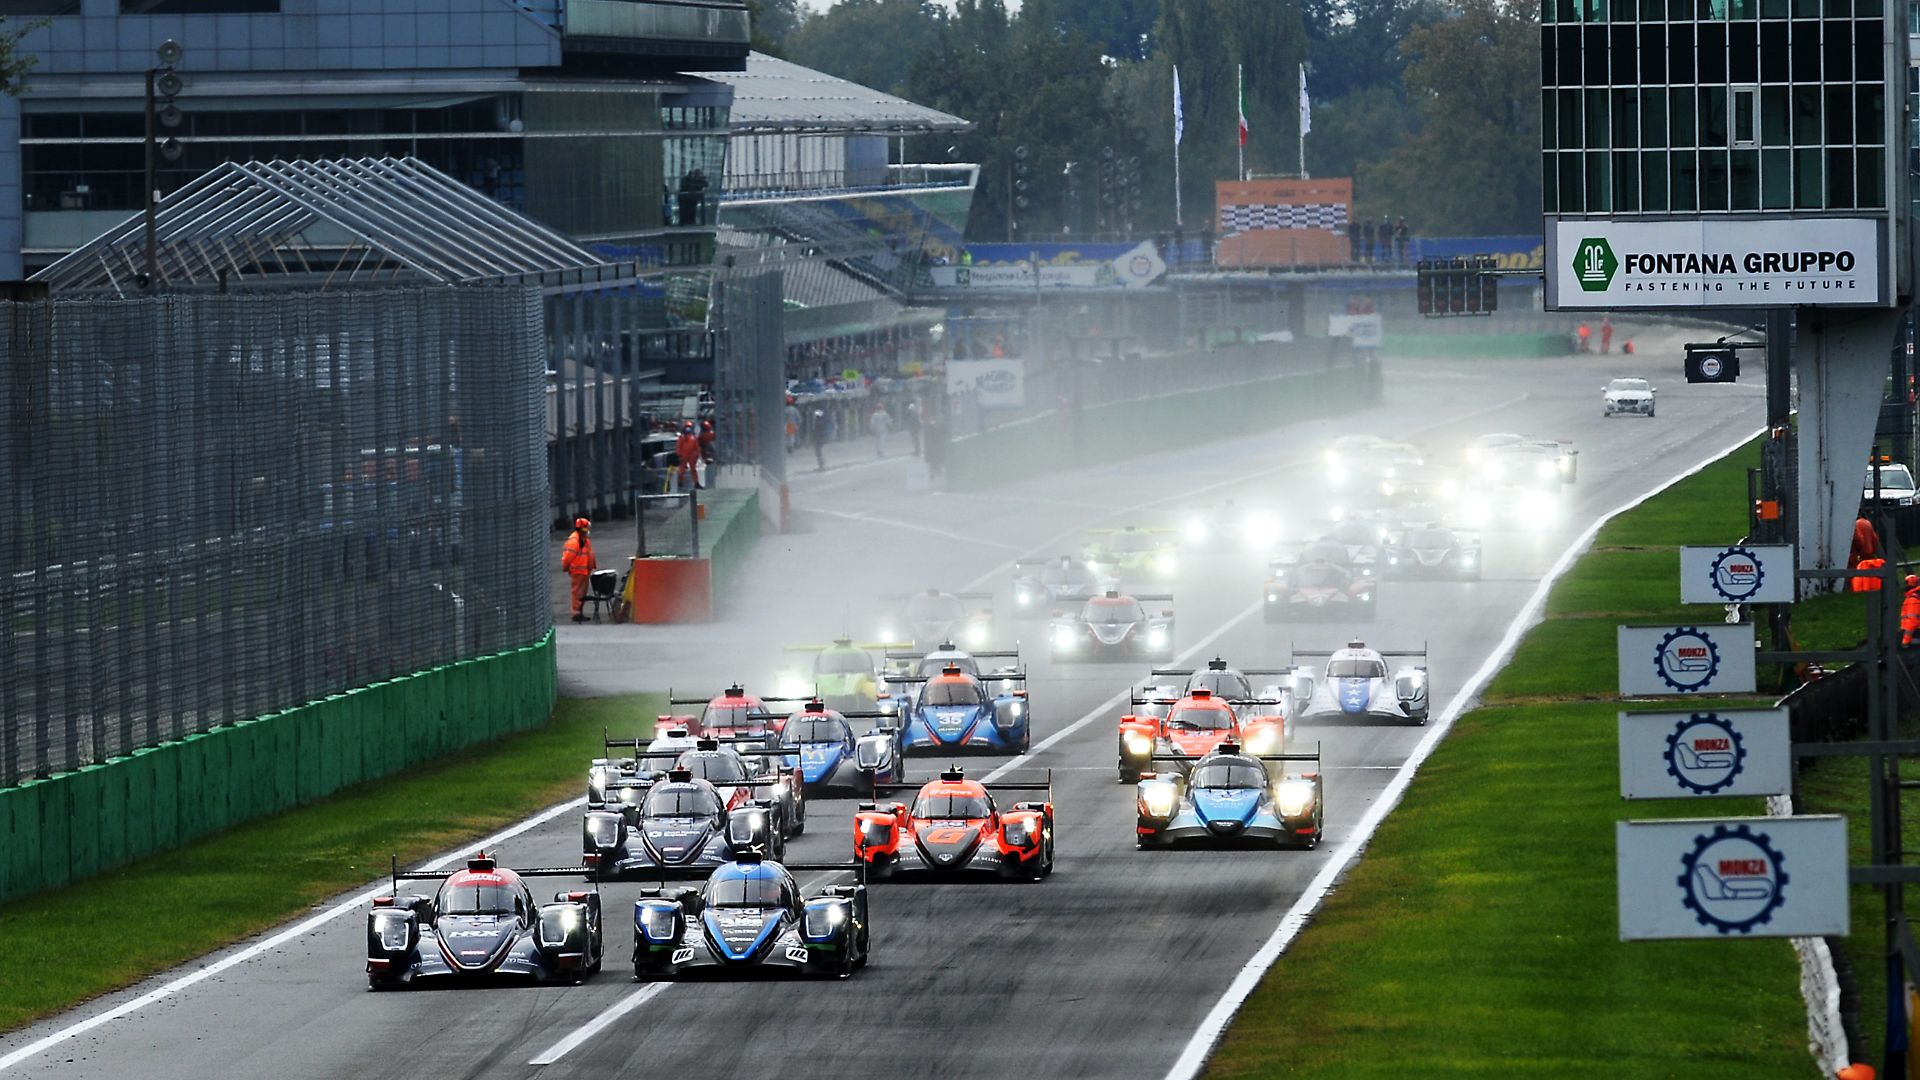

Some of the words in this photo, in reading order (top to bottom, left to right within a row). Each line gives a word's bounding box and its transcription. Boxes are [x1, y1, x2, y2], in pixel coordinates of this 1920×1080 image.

[1624, 252, 1737, 275] FONTANA
[1743, 250, 1855, 273] GRUPPO
[1624, 282, 1724, 292] FASTENING
[1738, 281, 1771, 291] THE
[1784, 280, 1856, 290] FUTURE
[1730, 564, 1754, 572] MONZA
[1678, 647, 1707, 657] MONZA
[1694, 738, 1729, 751] MONZA
[1718, 858, 1768, 876] MONZA
